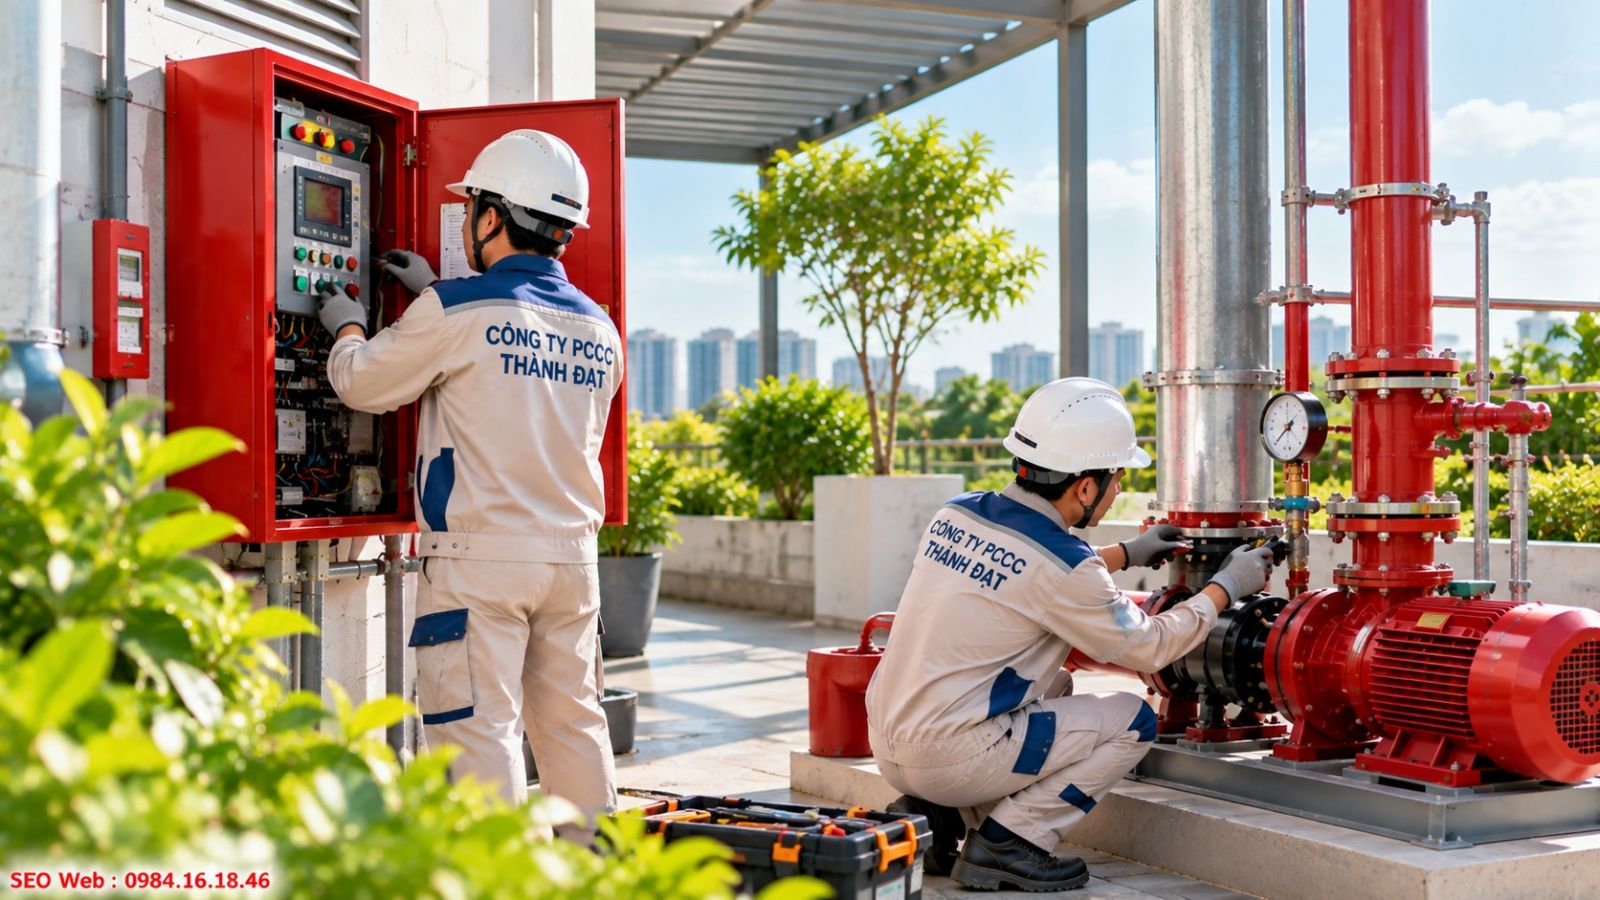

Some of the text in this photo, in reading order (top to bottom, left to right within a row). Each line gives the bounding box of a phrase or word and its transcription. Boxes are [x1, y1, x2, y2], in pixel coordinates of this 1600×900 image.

[486, 320, 614, 366] CÔNG TY PCCC
[500, 352, 606, 393] THÀNH ĐẠT
[964, 533, 985, 552] TY
[981, 542, 1027, 575] PCCC
[969, 562, 1008, 591] ĐẠT
